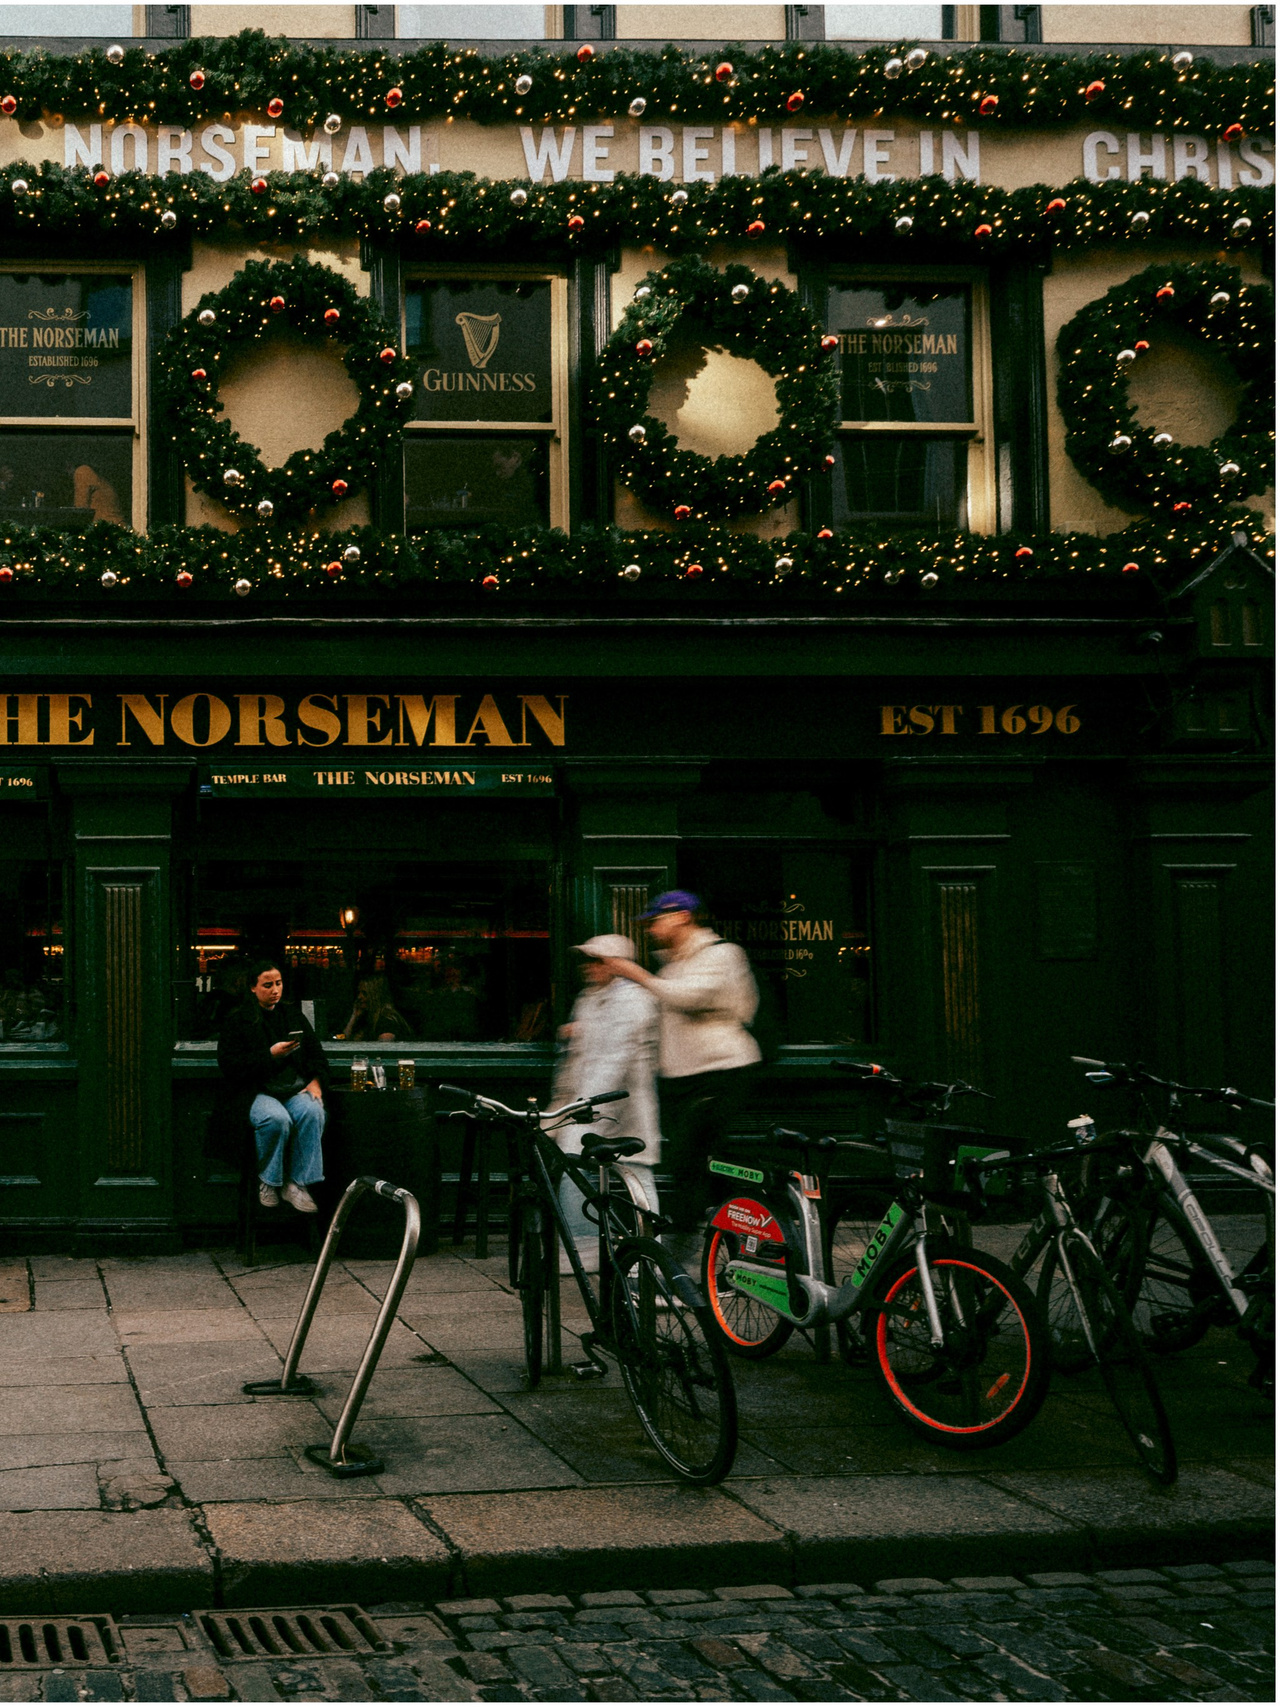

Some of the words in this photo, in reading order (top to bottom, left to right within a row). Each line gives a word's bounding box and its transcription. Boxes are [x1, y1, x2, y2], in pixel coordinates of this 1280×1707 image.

[520, 125, 614, 182] WE
[638, 126, 896, 183] BELIEVE
[920, 130, 980, 185] IN
[1083, 130, 1275, 189] CHRIS
[32, 327, 119, 348] NORSEMAN
[838, 334, 867, 354] THE
[872, 334, 957, 354] NORSEMAN
[28, 355, 79, 366] ESTABLISHED
[81, 356, 98, 367] 1696
[920, 362, 937, 373] 1696
[422, 368, 537, 392] GUINNESS
[116, 692, 570, 747] NORSEMAN
[878, 704, 963, 735] EST
[976, 704, 1081, 735] 1696
[7, 777, 33, 787] 1696
[212, 774, 259, 785] TEMPLE
[263, 773, 287, 784] BAR
[314, 771, 355, 785] THE
[365, 771, 476, 785] NORSEMAN
[501, 773, 523, 783] EST
[527, 774, 552, 784] 1696
[748, 920, 833, 940] NORSEMAN
[737, 1168, 760, 1180] MOBY
[728, 1209, 760, 1226] FREENOW
[857, 1212, 896, 1279] MOBY
[736, 1274, 757, 1286] MOBY
